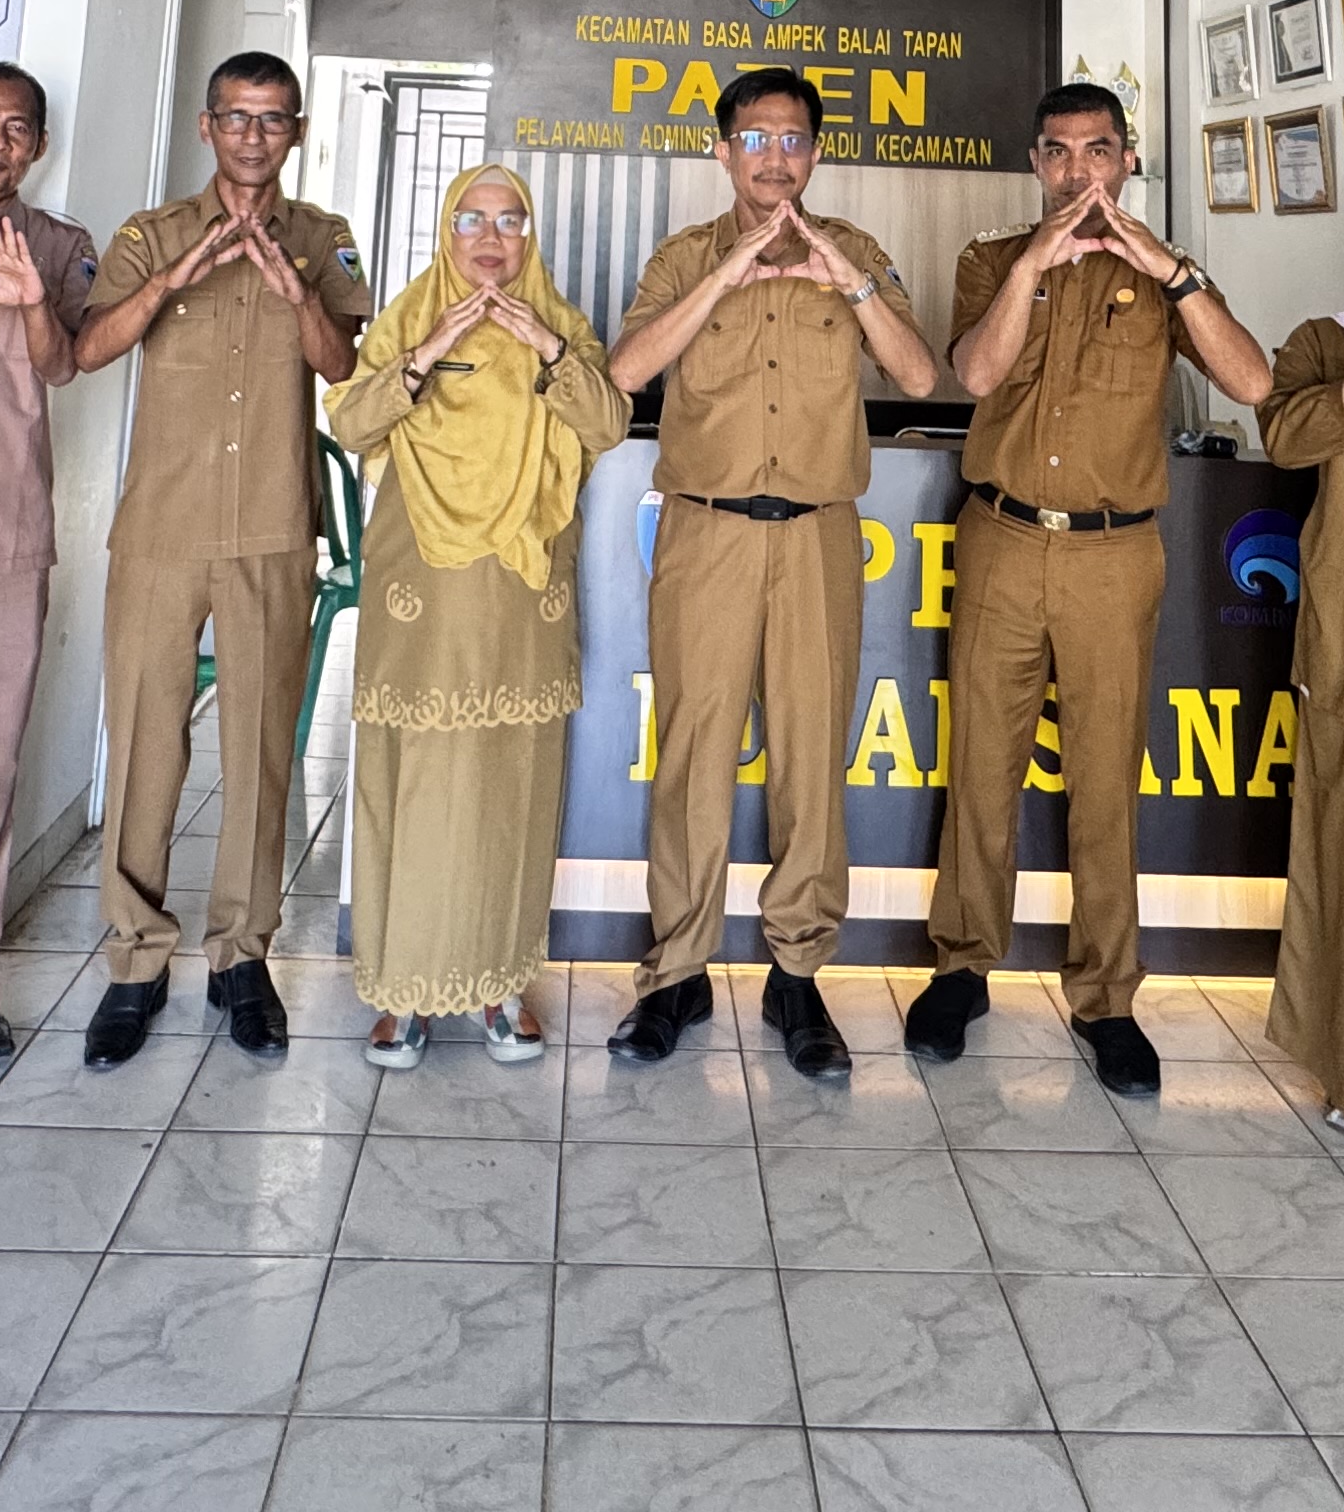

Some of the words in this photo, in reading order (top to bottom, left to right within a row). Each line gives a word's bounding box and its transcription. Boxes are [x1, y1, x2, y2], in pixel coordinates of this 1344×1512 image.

[576, 15, 690, 46] KECAMATAN
[703, 21, 753, 49] BASA
[764, 24, 826, 52] AMPEK
[838, 27, 891, 56] BALAI
[903, 30, 962, 59] TAPAN
[612, 57, 925, 126] PAEN
[516, 117, 625, 148] PELAYANAN
[876, 134, 992, 165] KECAMATAN
